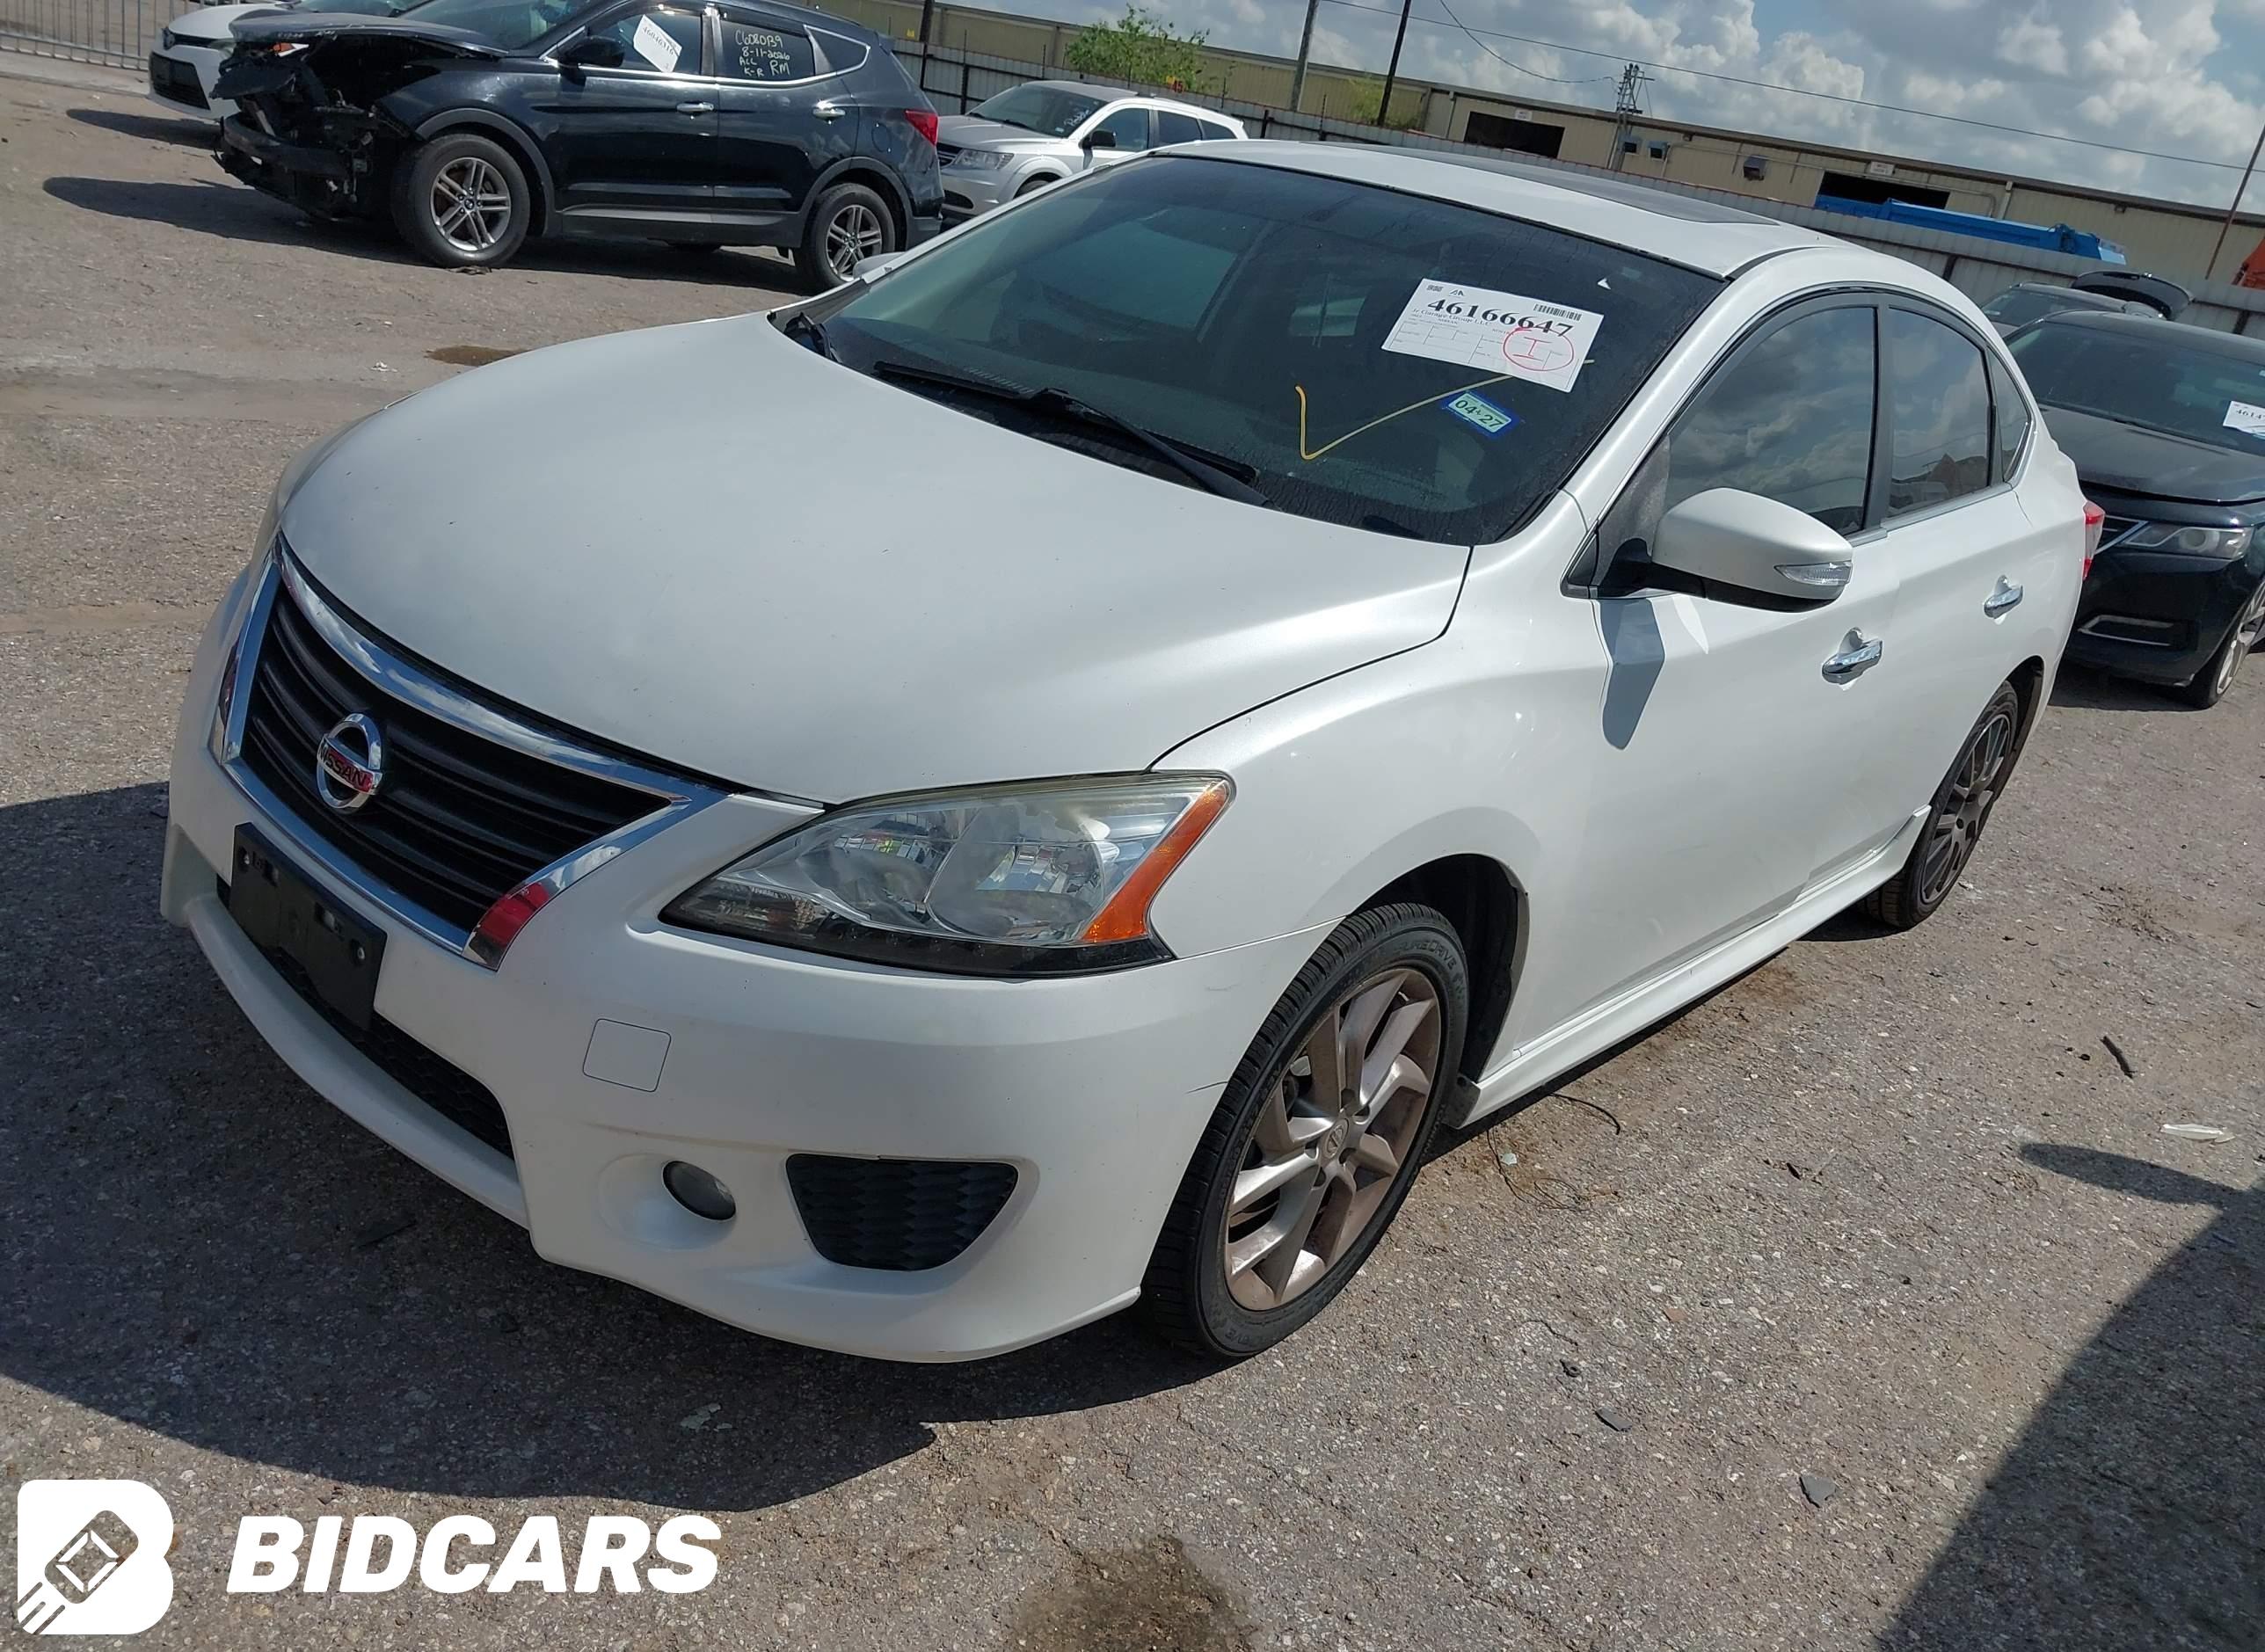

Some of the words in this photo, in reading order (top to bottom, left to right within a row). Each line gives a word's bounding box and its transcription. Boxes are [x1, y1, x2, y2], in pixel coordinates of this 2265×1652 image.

[1427, 299, 1574, 337] 46166647
[1455, 400, 1477, 414] 04
[1478, 414, 1504, 427] 27
[319, 740, 368, 788] NISSAN
